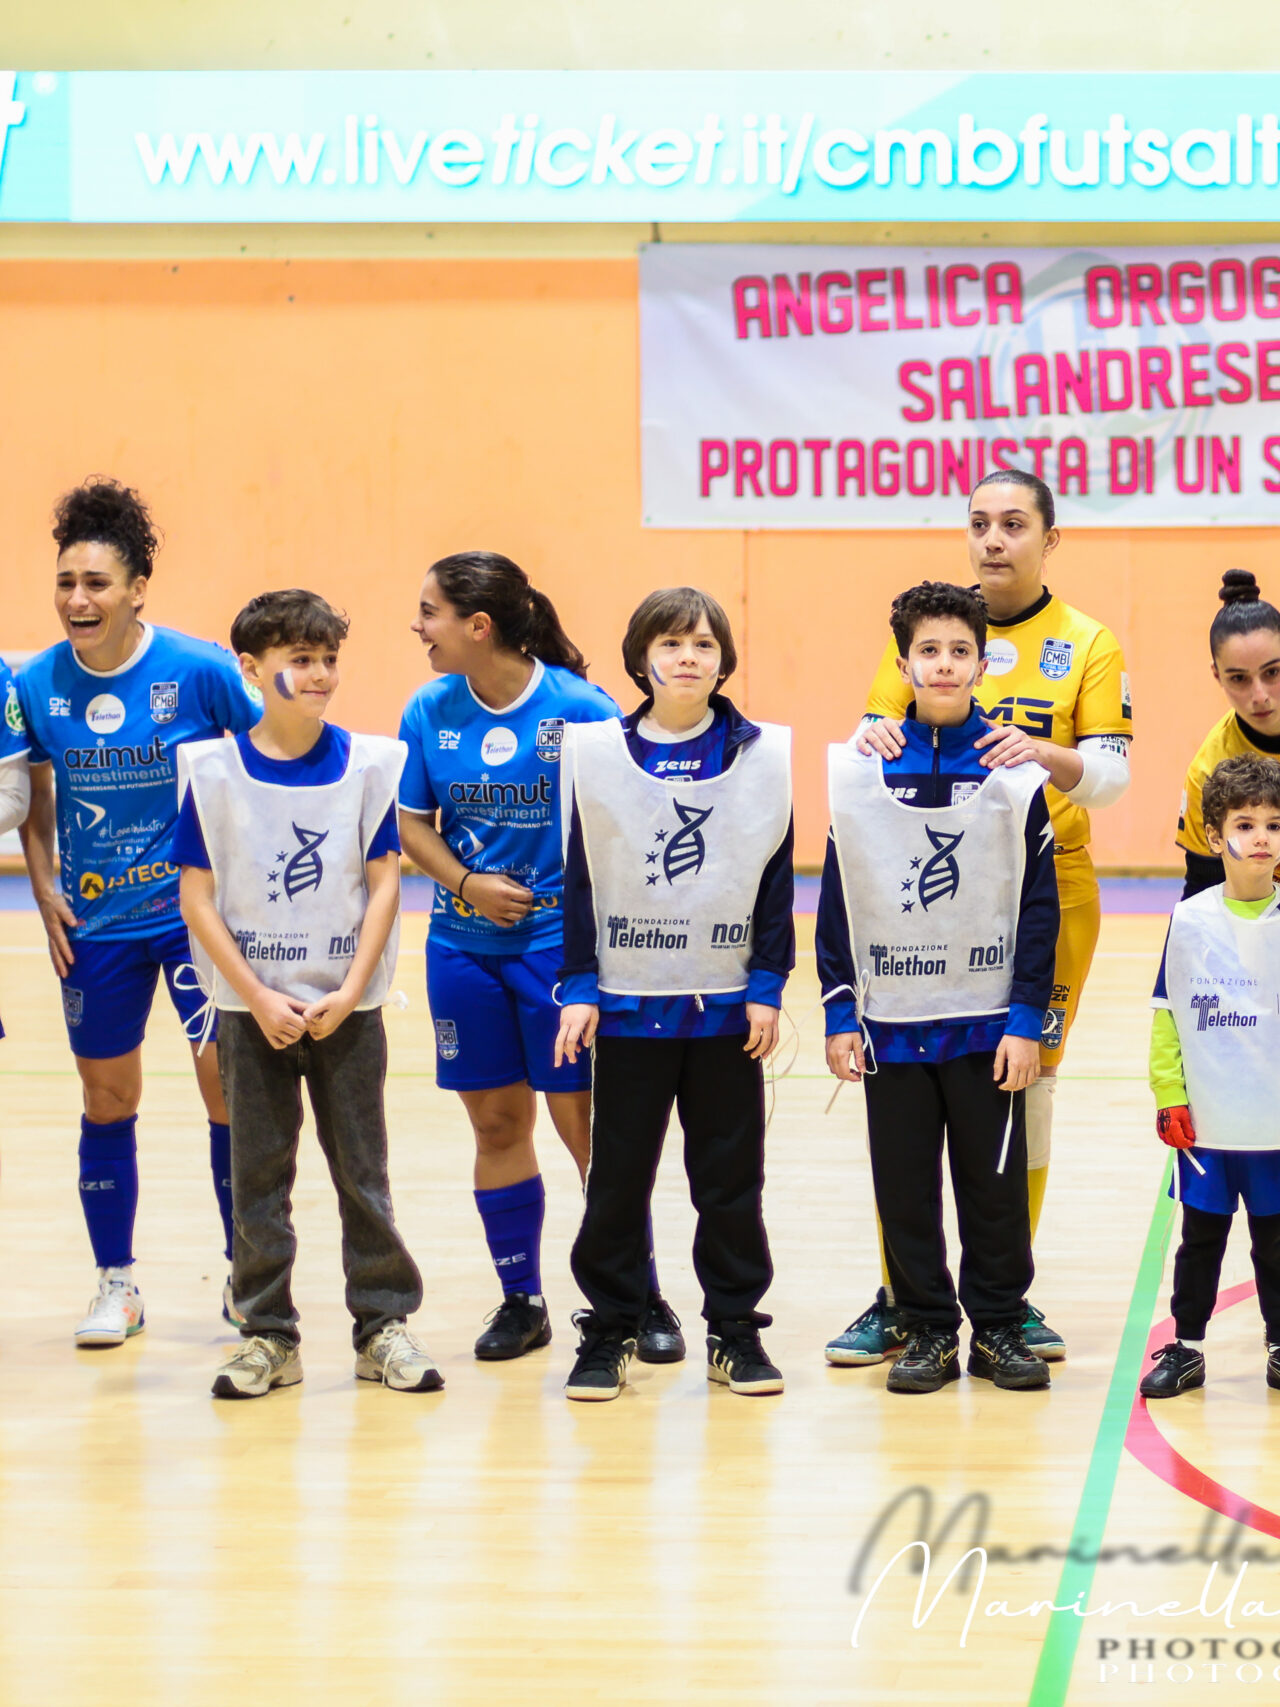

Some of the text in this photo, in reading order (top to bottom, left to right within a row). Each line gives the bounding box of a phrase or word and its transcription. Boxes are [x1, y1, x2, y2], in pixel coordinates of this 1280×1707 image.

[731, 261, 1023, 340] ANGELICA
[699, 434, 1090, 498] PROTAGONISTA
[1109, 435, 1155, 496] DI
[1175, 434, 1242, 496] UN
[1046, 651, 1067, 665] CMB
[63, 734, 168, 770] azimut
[540, 732, 561, 745] CMB
[68, 765, 172, 783] investimenti
[654, 759, 702, 773] Zeus
[449, 772, 552, 805] azimut
[456, 804, 550, 820] investimenti
[607, 914, 688, 950] Telethon
[632, 917, 691, 926] FONDAZIONE
[711, 913, 752, 944] noi
[236, 929, 308, 961] Telethon
[869, 942, 947, 977] Telethon
[890, 944, 949, 952] FONDAZIONE
[968, 934, 1004, 967] noi
[1190, 977, 1259, 987] FONDAZIONE
[1190, 993, 1258, 1032] Telethon
